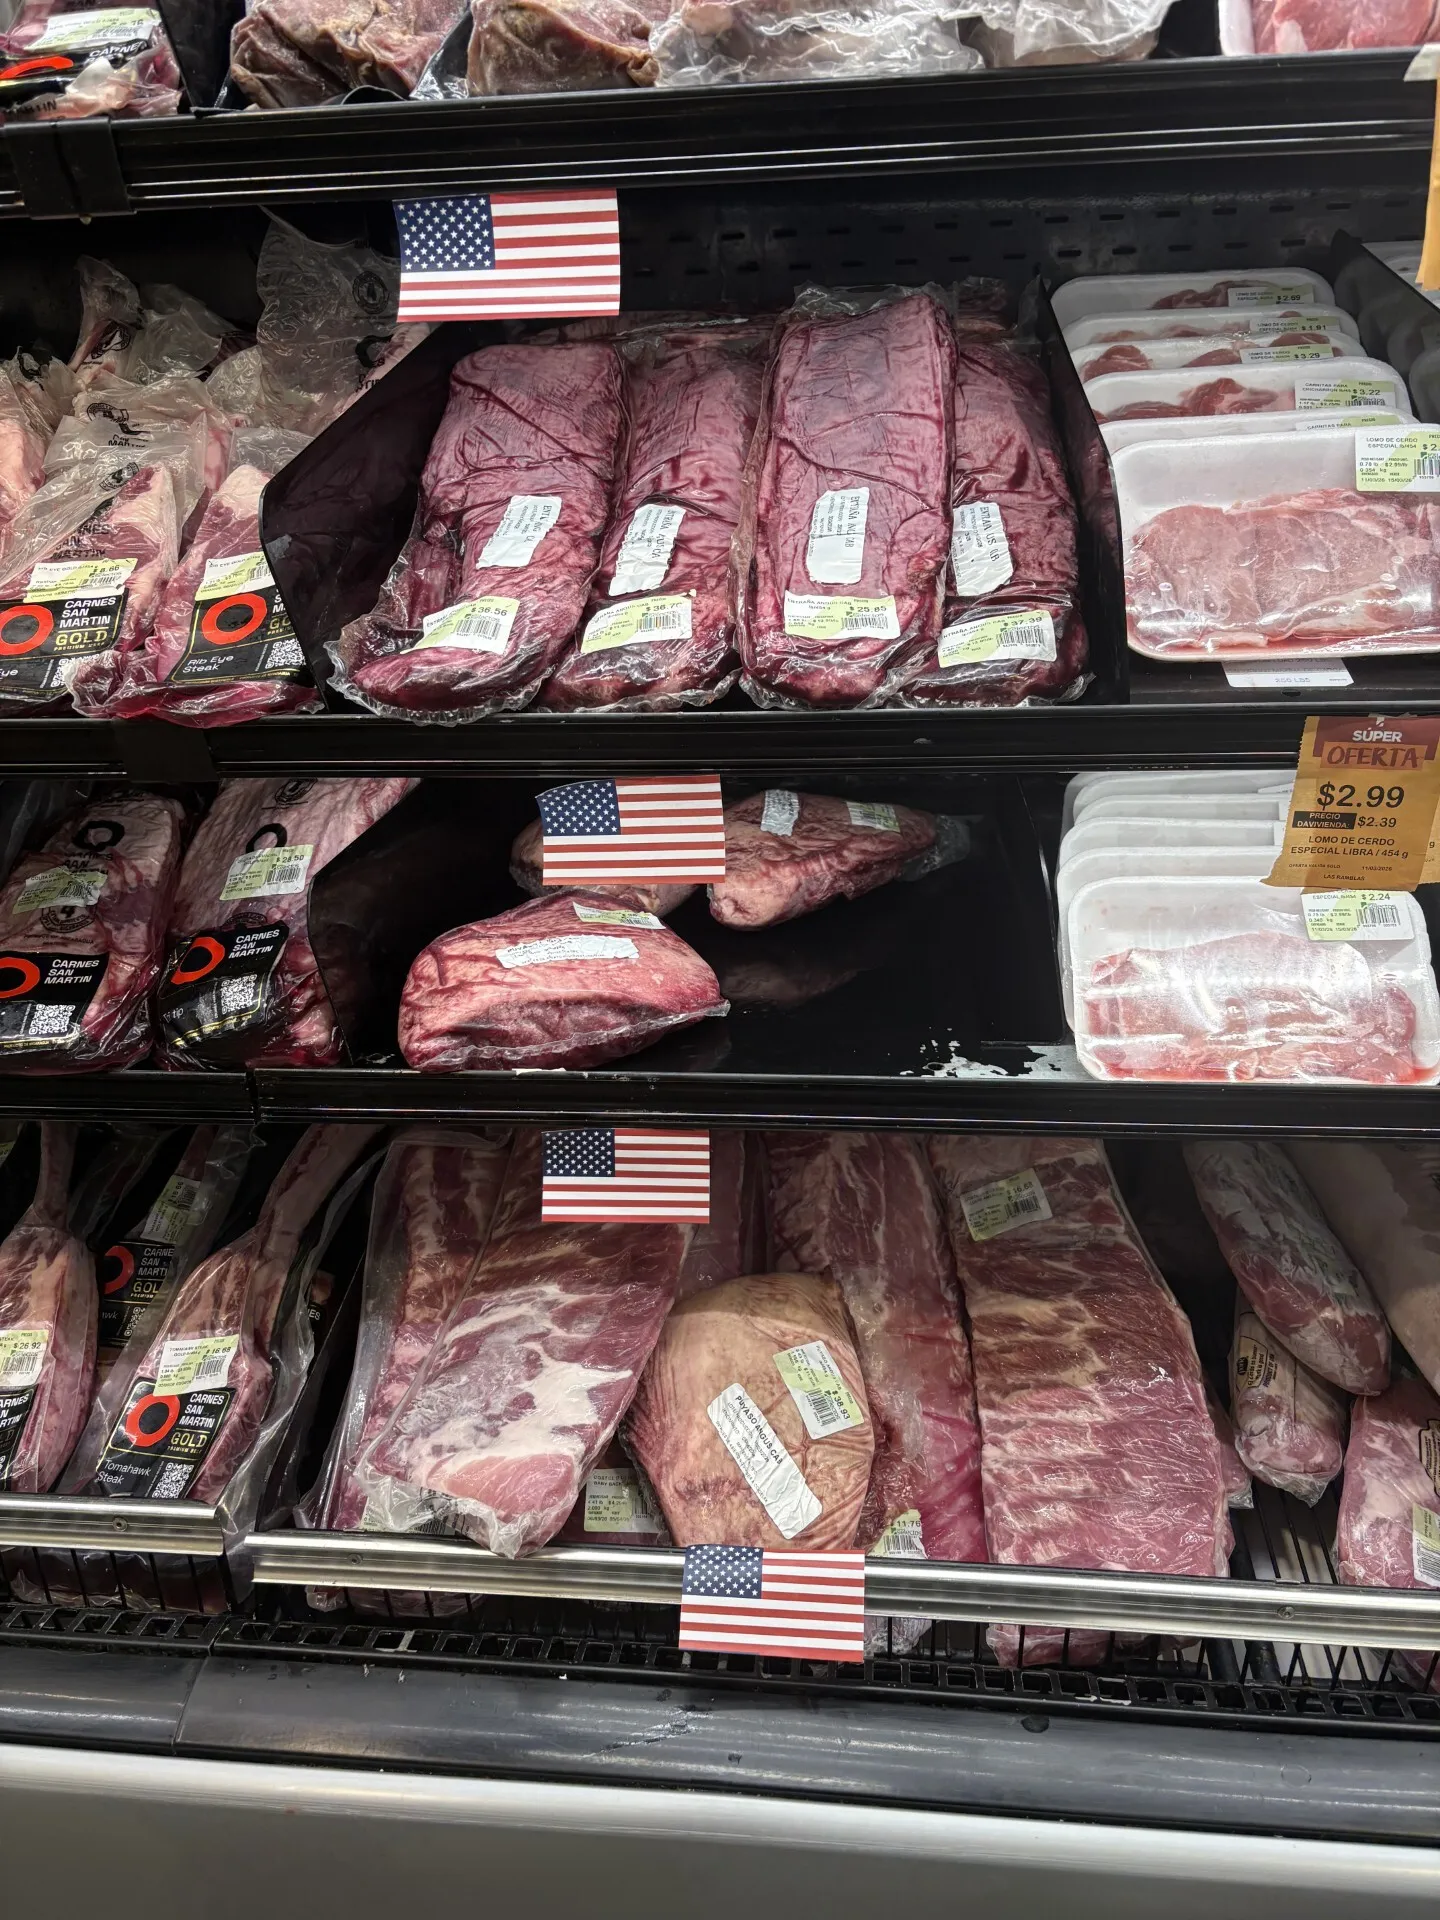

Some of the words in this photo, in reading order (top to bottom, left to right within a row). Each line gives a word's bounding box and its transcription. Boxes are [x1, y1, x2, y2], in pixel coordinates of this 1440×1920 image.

[1422, 443, 1428, 451] $
[64, 597, 117, 609] CARNES
[61, 608, 90, 619] SAN
[477, 606, 508, 616] 36.56
[59, 615, 111, 628] MARTIN
[55, 630, 108, 646] GOLD
[210, 655, 234, 664] Eye
[182, 664, 221, 673] Steak
[1352, 727, 1403, 743] SÚPER
[1326, 745, 1419, 768] OFERTA
[1316, 780, 1405, 811] $2.99
[1309, 812, 1341, 820] PRECIO
[1297, 820, 1351, 829] DAVIVIENDA:
[1357, 815, 1397, 829] $2.39
[1308, 835, 1339, 844] LOMO
[1340, 836, 1356, 845] DE
[1357, 837, 1395, 846] CERDO
[1290, 846, 1341, 855] ESPECIAL
[1342, 847, 1374, 856] LIBRA
[1381, 849, 1400, 857] 454
[1401, 851, 1409, 859] g
[282, 854, 305, 863] 28.50
[1361, 893, 1367, 901] $
[1369, 893, 1391, 901] 2.24
[235, 929, 280, 944] CARNES
[228, 945, 274, 959] MARTIN
[232, 941, 256, 952] SAN
[52, 958, 100, 969] CARNES
[48, 968, 75, 977] SAN
[43, 975, 93, 985] MARTIN
[172, 1007, 184, 1019] tip
[143, 1248, 175, 1257] CARNE
[140, 1257, 160, 1266] SAN
[138, 1267, 168, 1276] MARTI
[132, 1282, 163, 1293] GOL
[189, 1393, 224, 1405] CARNES
[184, 1404, 205, 1415] SAN
[833, 1395, 851, 1420] 38.93
[178, 1415, 216, 1428] MARTIN
[735, 1395, 758, 1426] PUYASO
[755, 1424, 773, 1451] ANGUS
[770, 1449, 783, 1465] CAB
[170, 1431, 208, 1448] GOLD
[104, 1459, 152, 1476] Tomahawk
[96, 1470, 125, 1485] Steak
